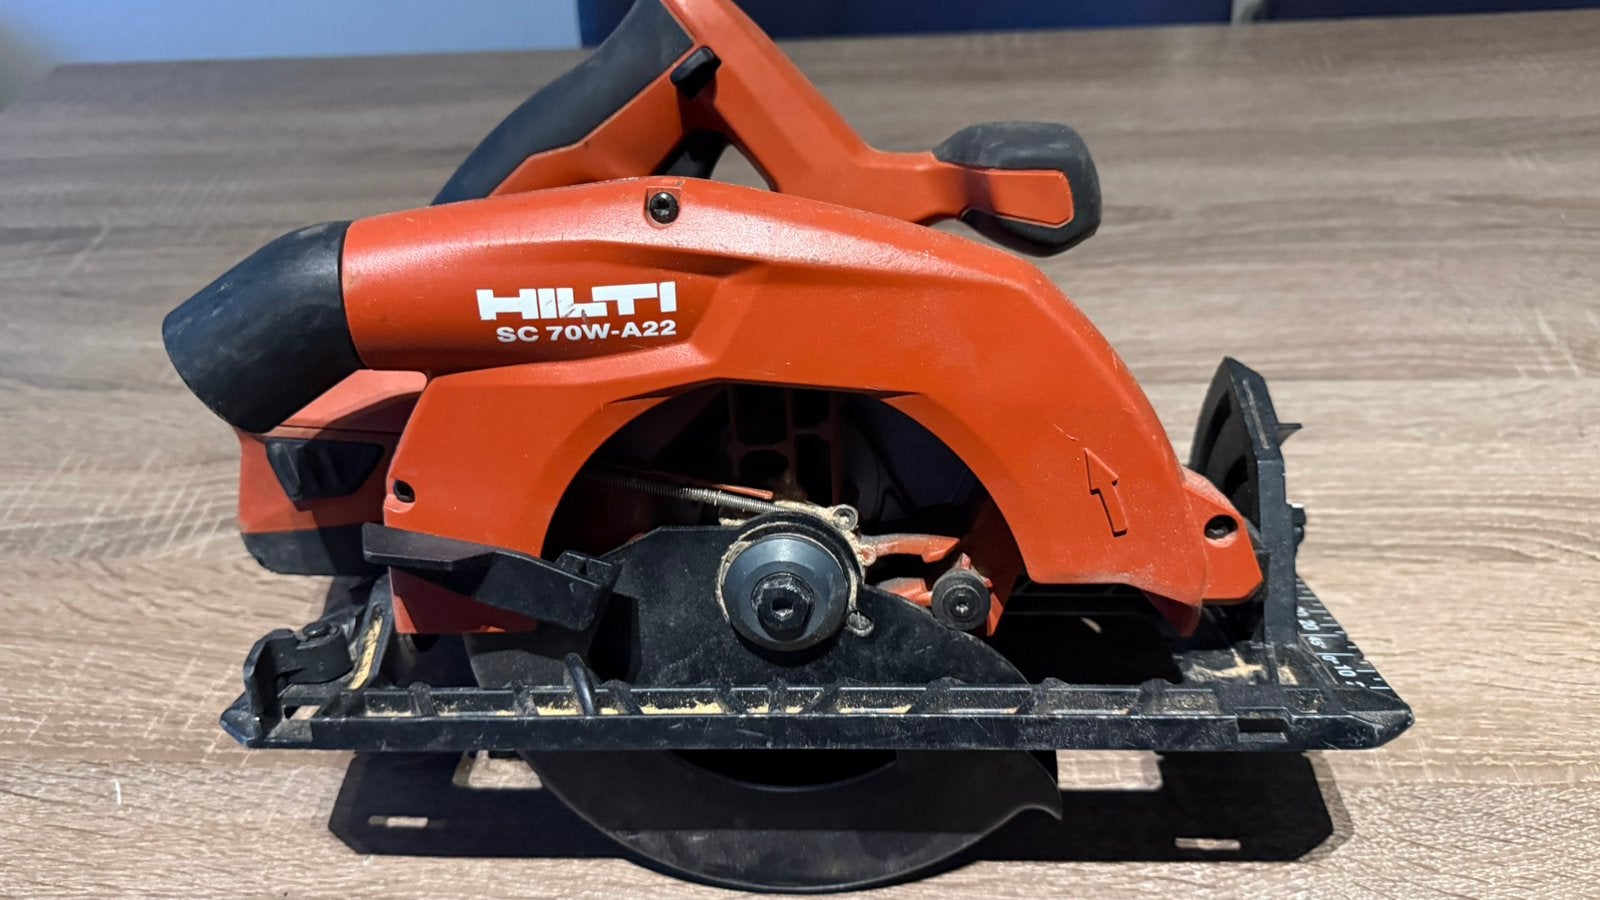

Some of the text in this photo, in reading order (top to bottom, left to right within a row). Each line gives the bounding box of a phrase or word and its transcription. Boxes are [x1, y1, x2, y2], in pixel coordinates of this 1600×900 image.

[476, 281, 677, 320] HILTI
[496, 320, 677, 343] SC 70W-A22
[1297, 619, 1320, 631] 20
[1333, 664, 1357, 677] 10
